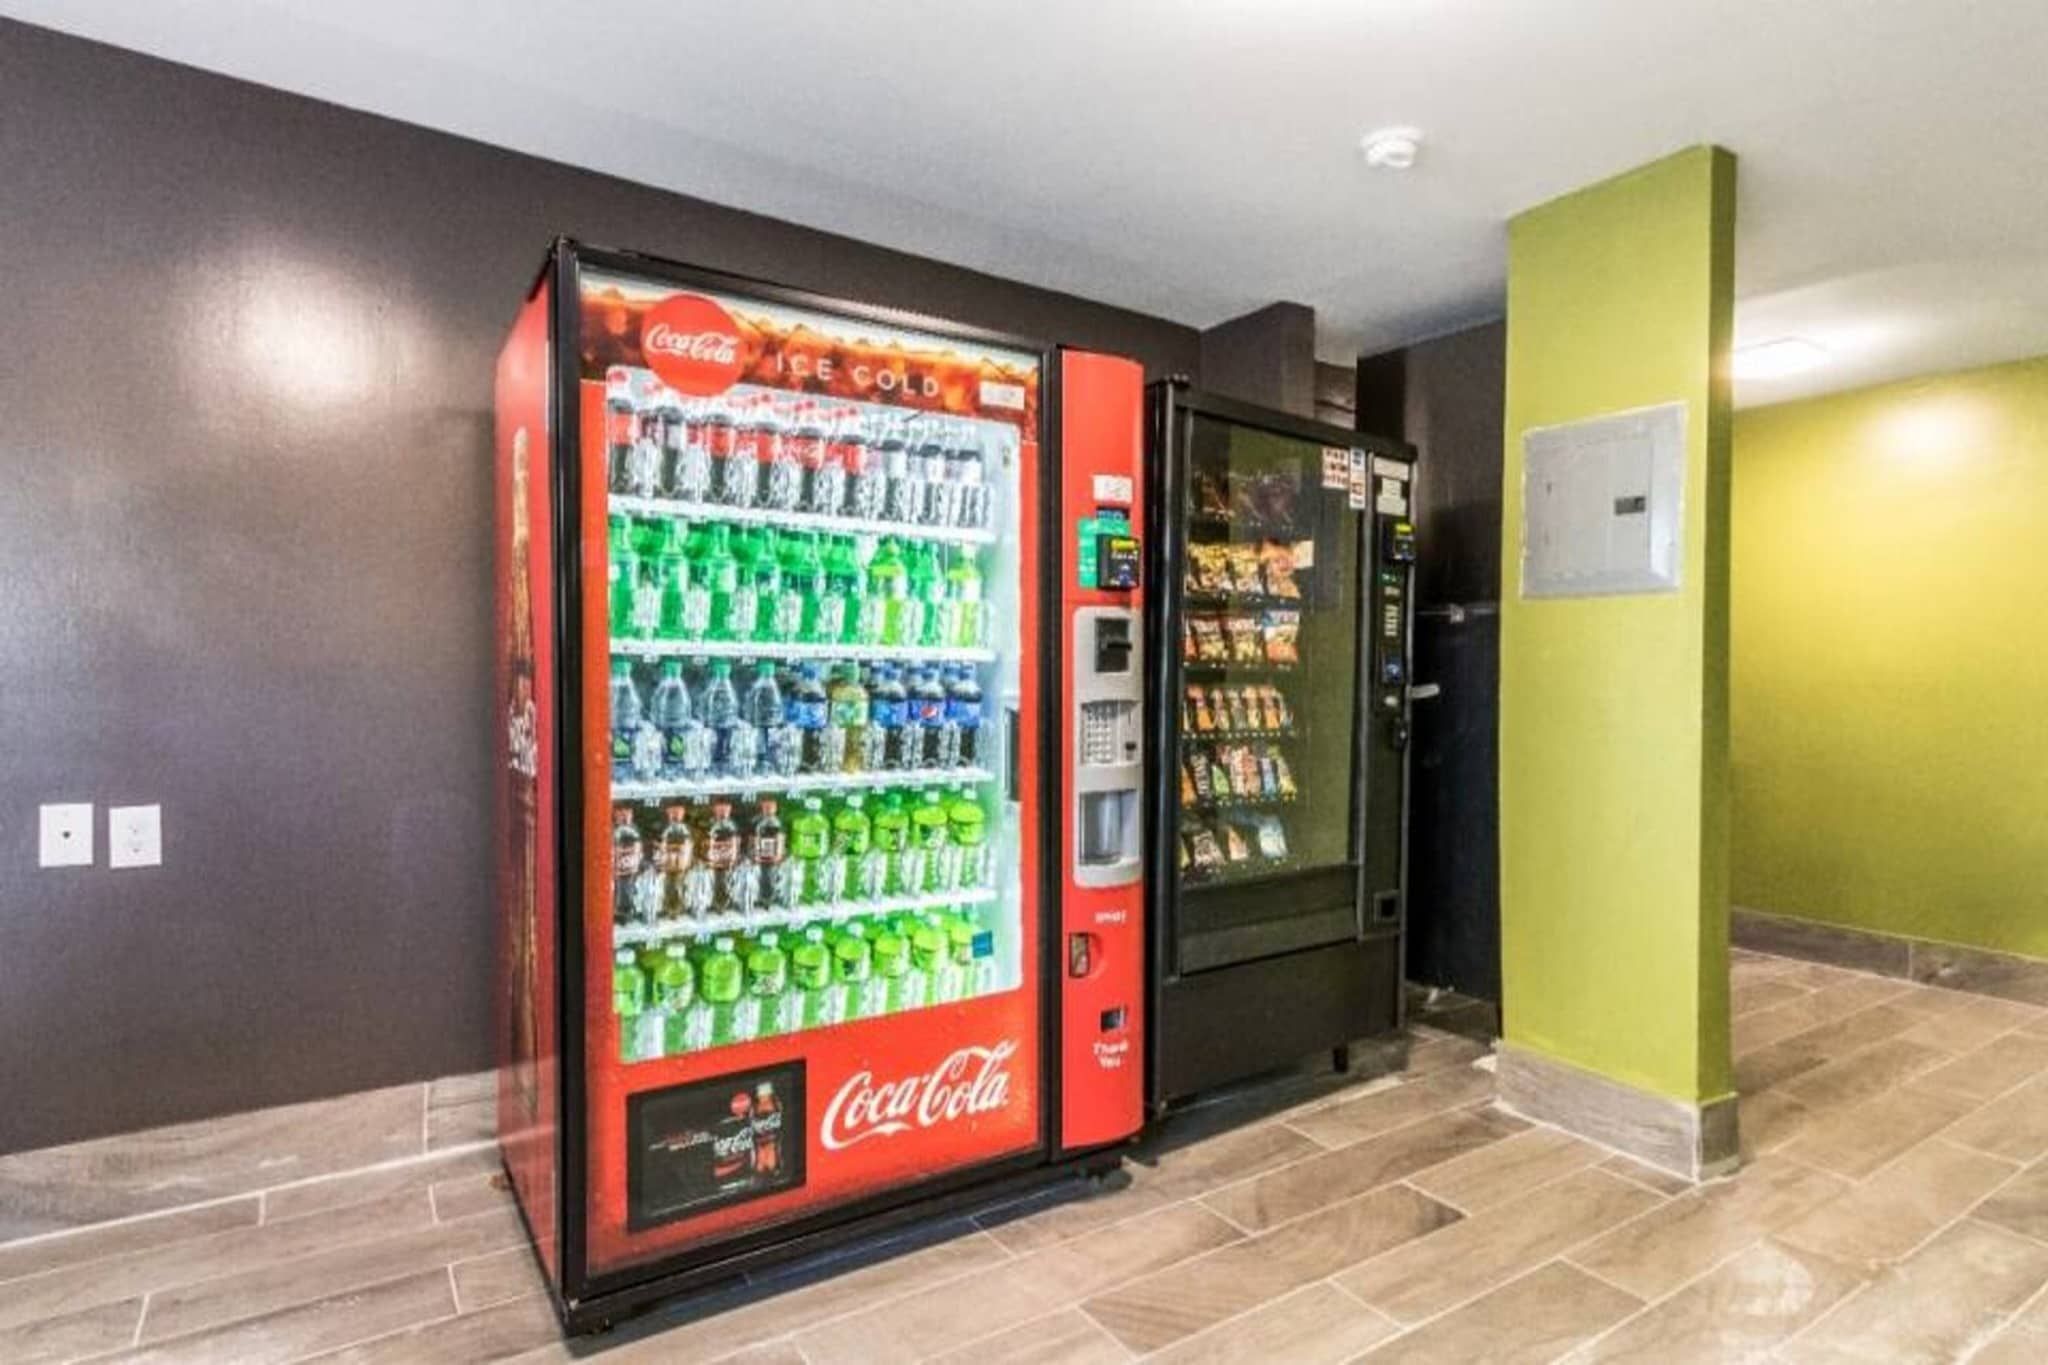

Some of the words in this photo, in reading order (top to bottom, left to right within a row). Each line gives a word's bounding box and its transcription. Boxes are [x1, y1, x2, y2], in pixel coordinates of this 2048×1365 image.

[645, 324, 740, 365] Coca-Cola
[775, 353, 834, 382] ICE
[853, 364, 940, 397] COLD
[820, 1038, 1019, 1150] Coca-Cola
